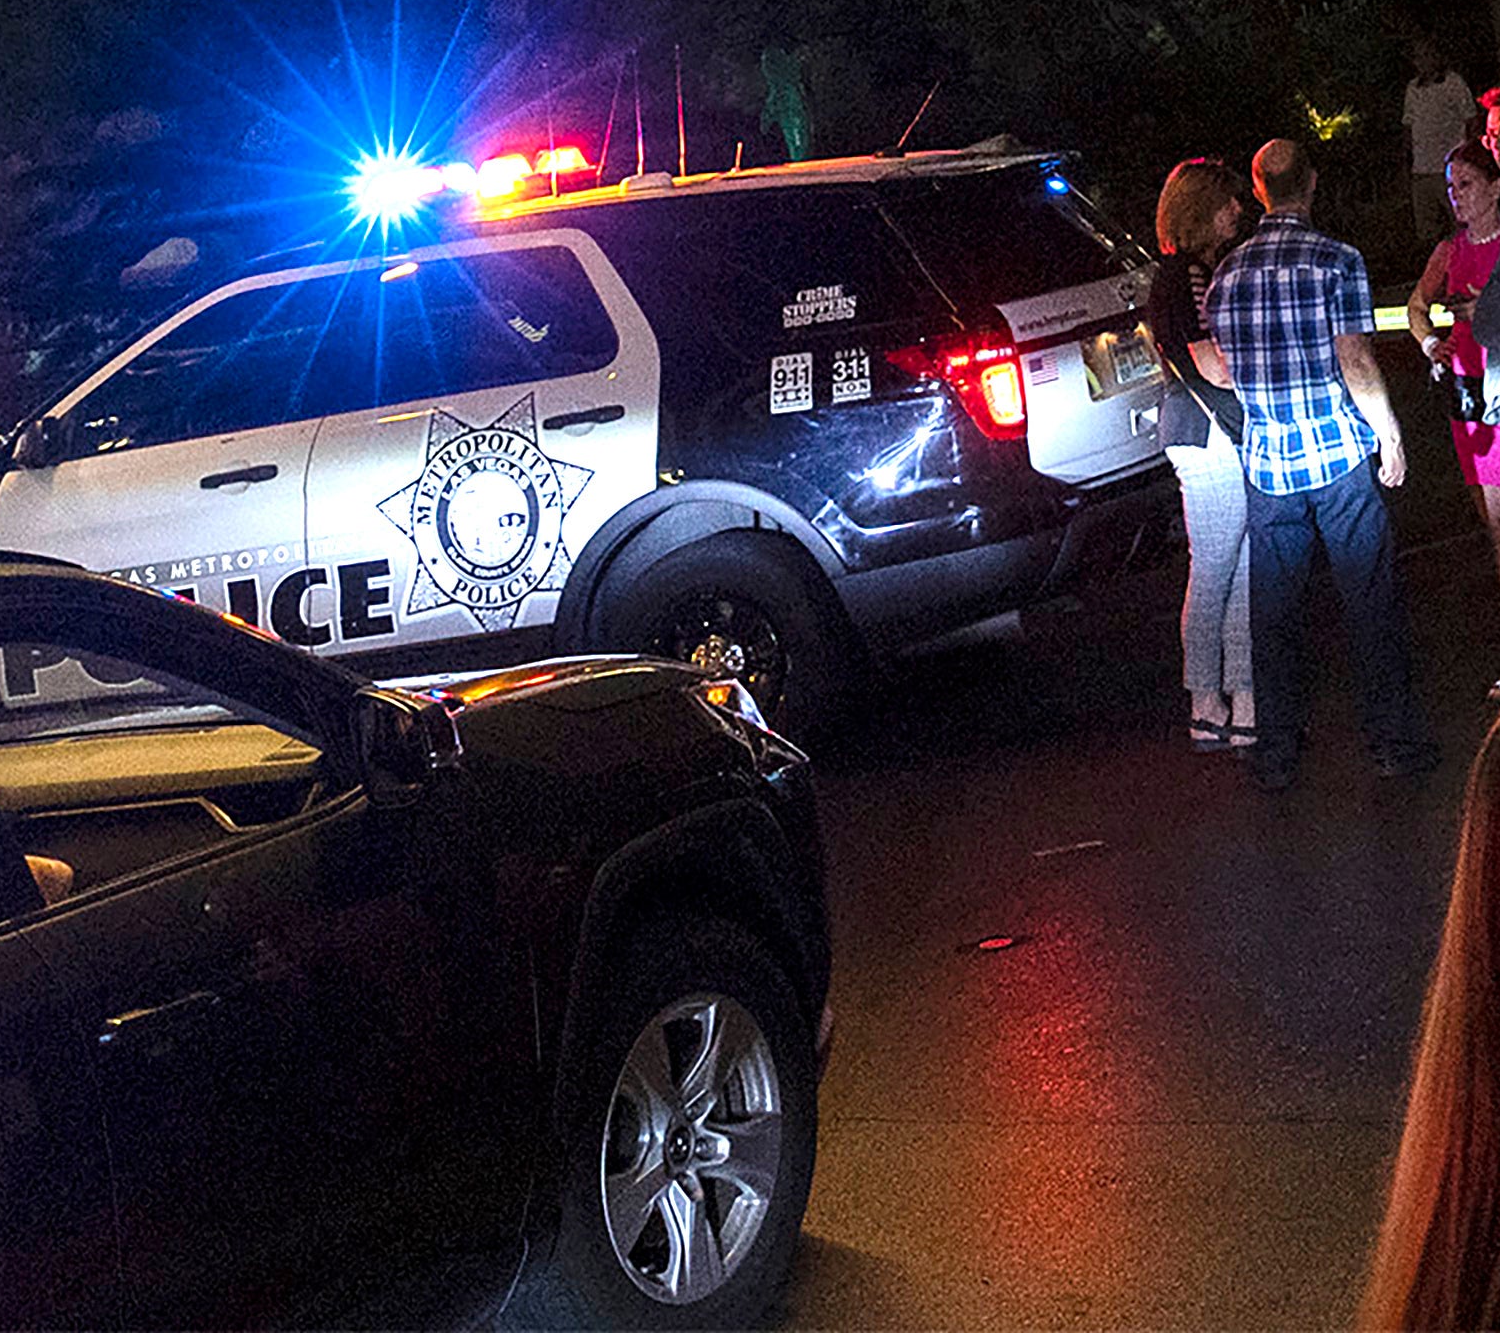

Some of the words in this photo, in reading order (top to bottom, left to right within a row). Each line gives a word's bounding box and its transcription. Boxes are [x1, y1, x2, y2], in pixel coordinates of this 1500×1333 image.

[783, 295, 857, 316] STOPPERS
[835, 347, 866, 360] DIAL
[835, 381, 868, 394] NON
[417, 433, 558, 525] METROPOLITAN
[451, 566, 539, 605] POLICE
